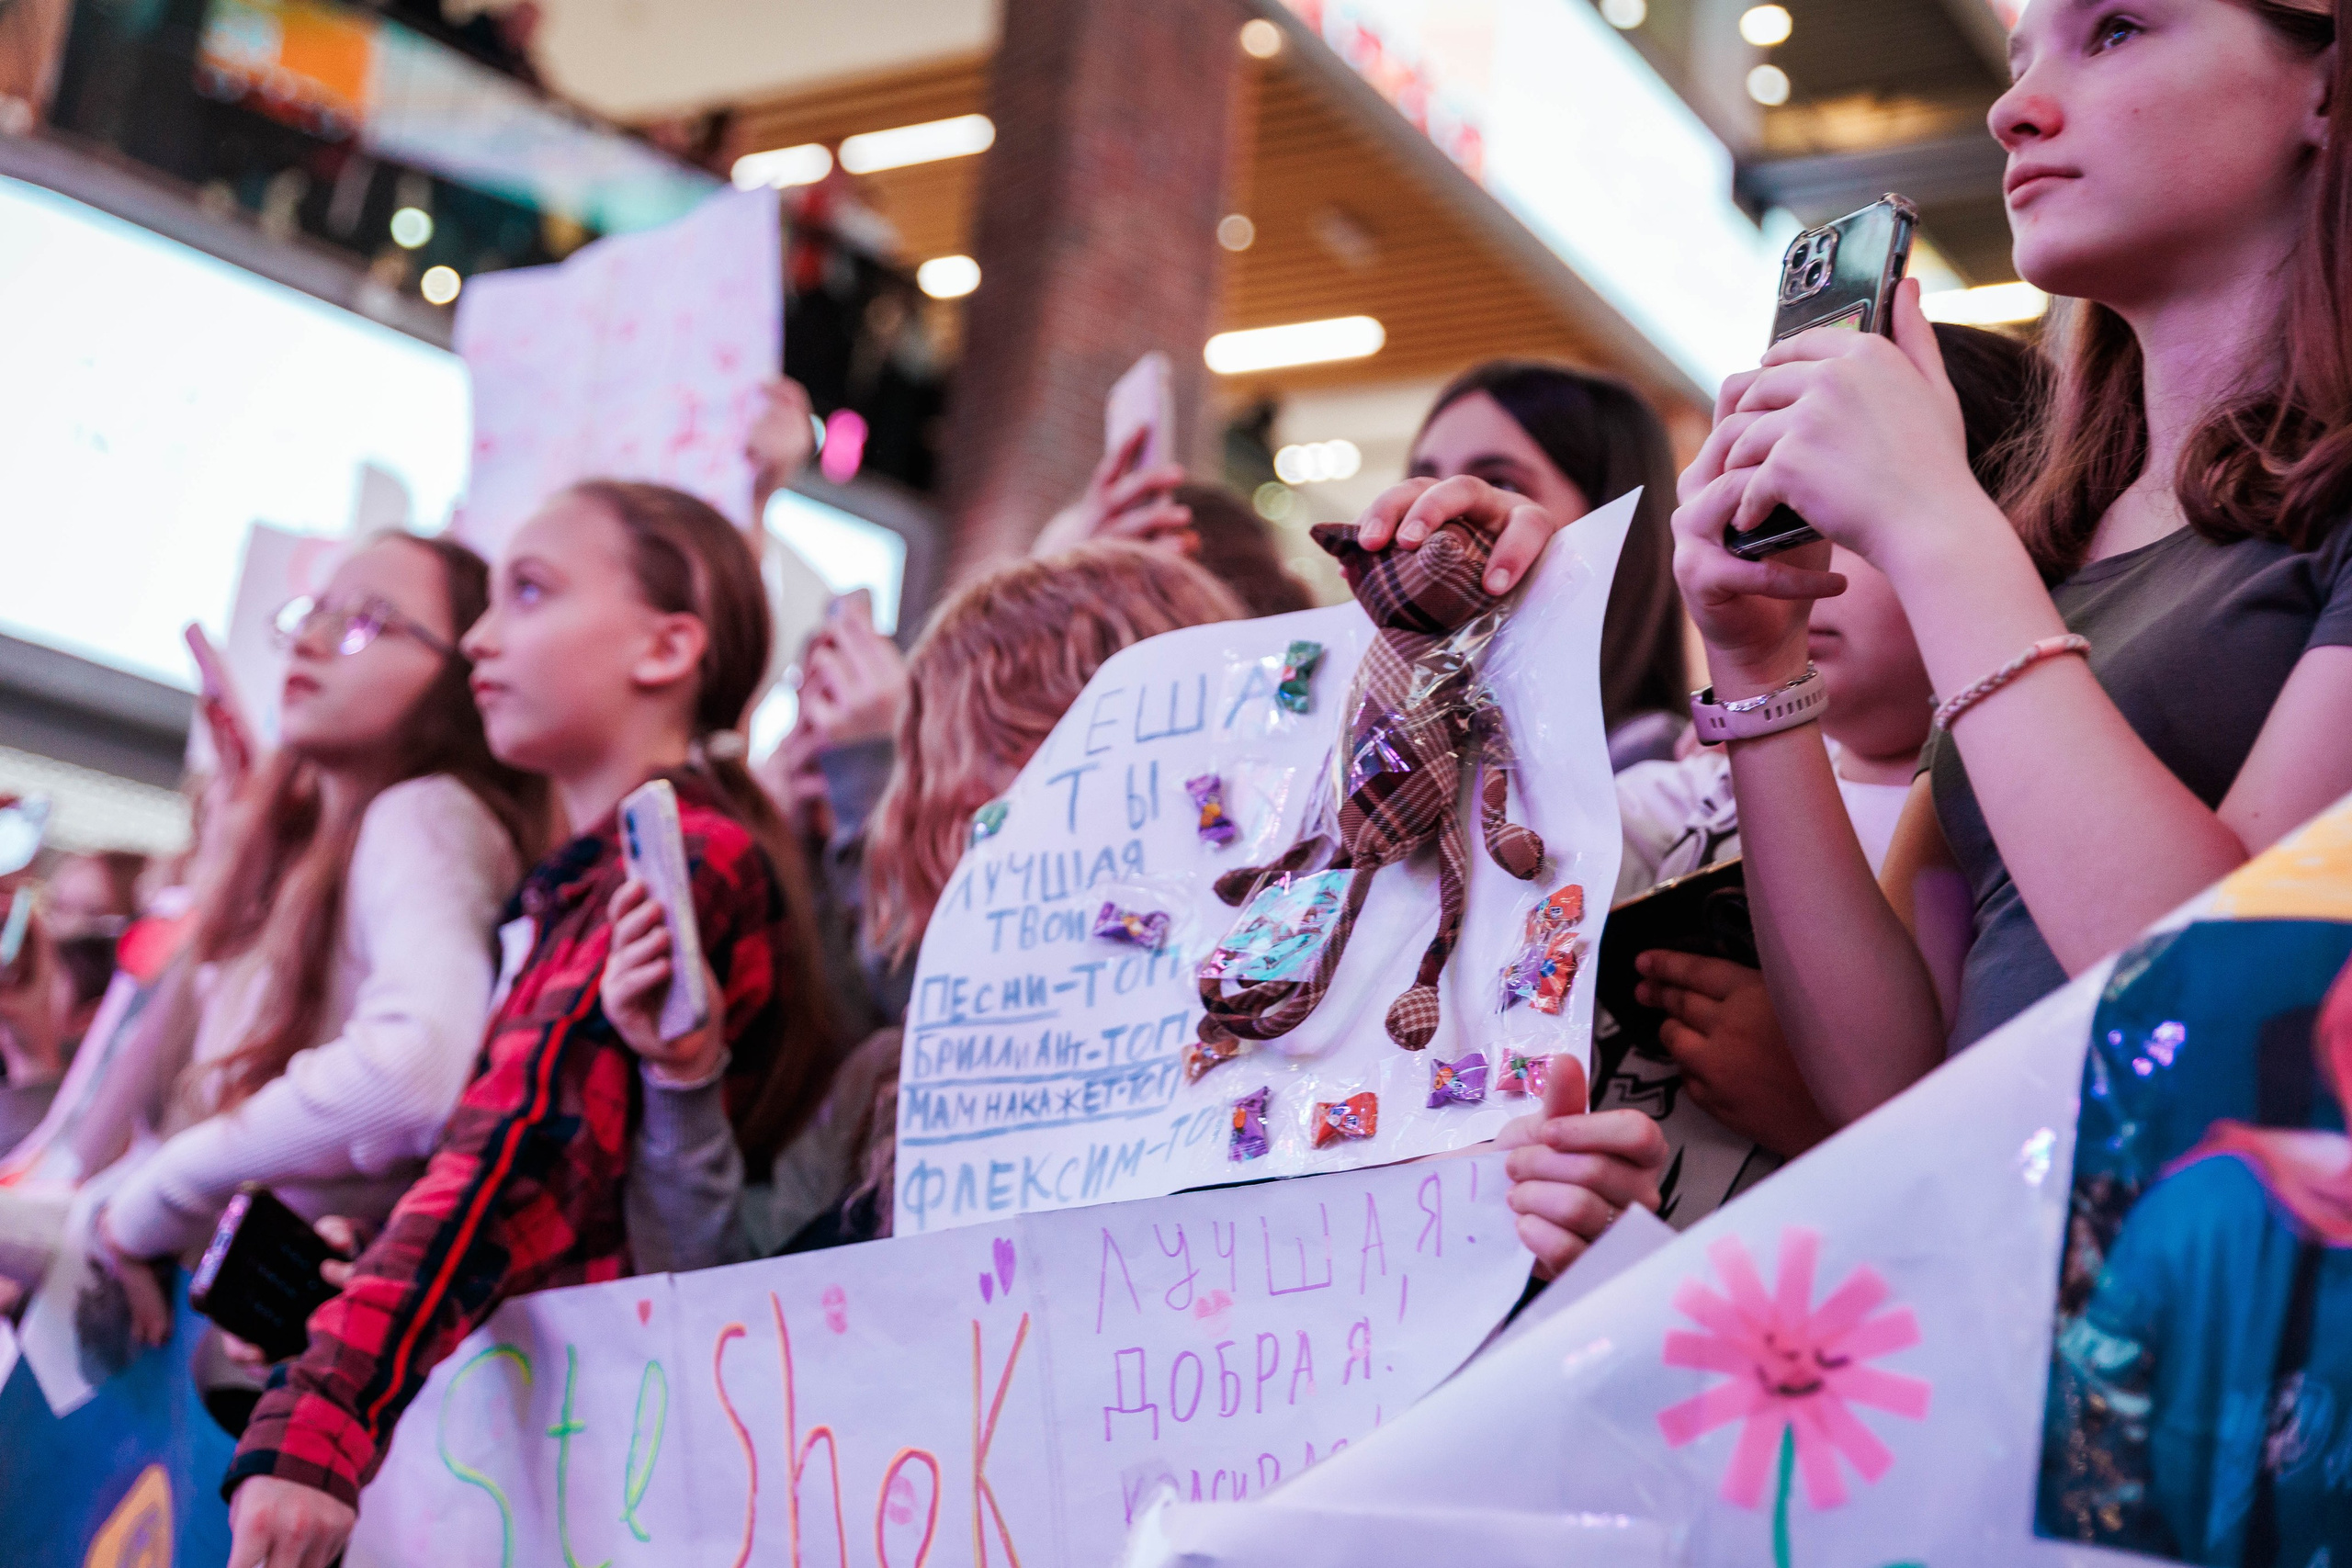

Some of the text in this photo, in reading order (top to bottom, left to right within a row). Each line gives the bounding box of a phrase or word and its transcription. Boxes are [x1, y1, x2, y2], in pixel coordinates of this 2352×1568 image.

[1046, 666, 1273, 762] ЕША
[1046, 759, 1160, 834] ТЫ
[943, 839, 1145, 915] ЛУЧШАЯ
[1096, 1161, 1477, 1335] ЛУЧШАЯ!
